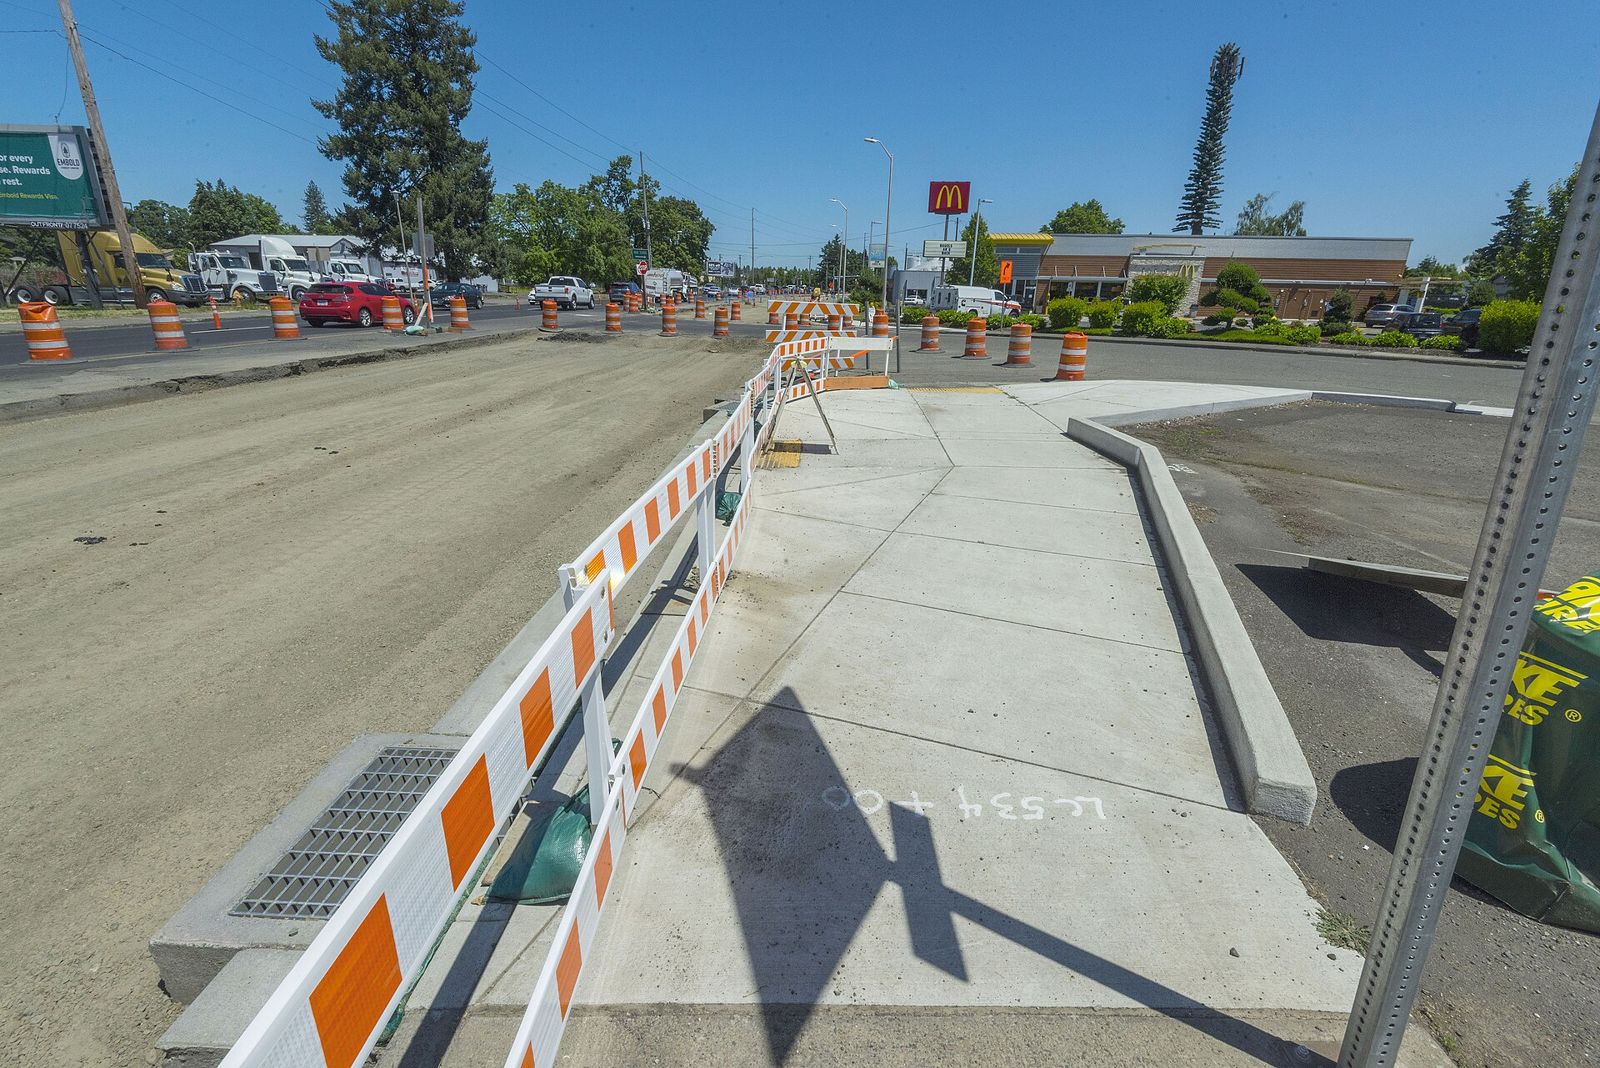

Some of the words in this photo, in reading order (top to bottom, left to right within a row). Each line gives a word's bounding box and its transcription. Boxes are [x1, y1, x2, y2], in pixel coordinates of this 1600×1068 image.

[9, 155, 33, 164] every
[57, 158, 80, 166] EMBOLD
[12, 165, 51, 175] Rewards
[3, 178, 23, 186] rest.
